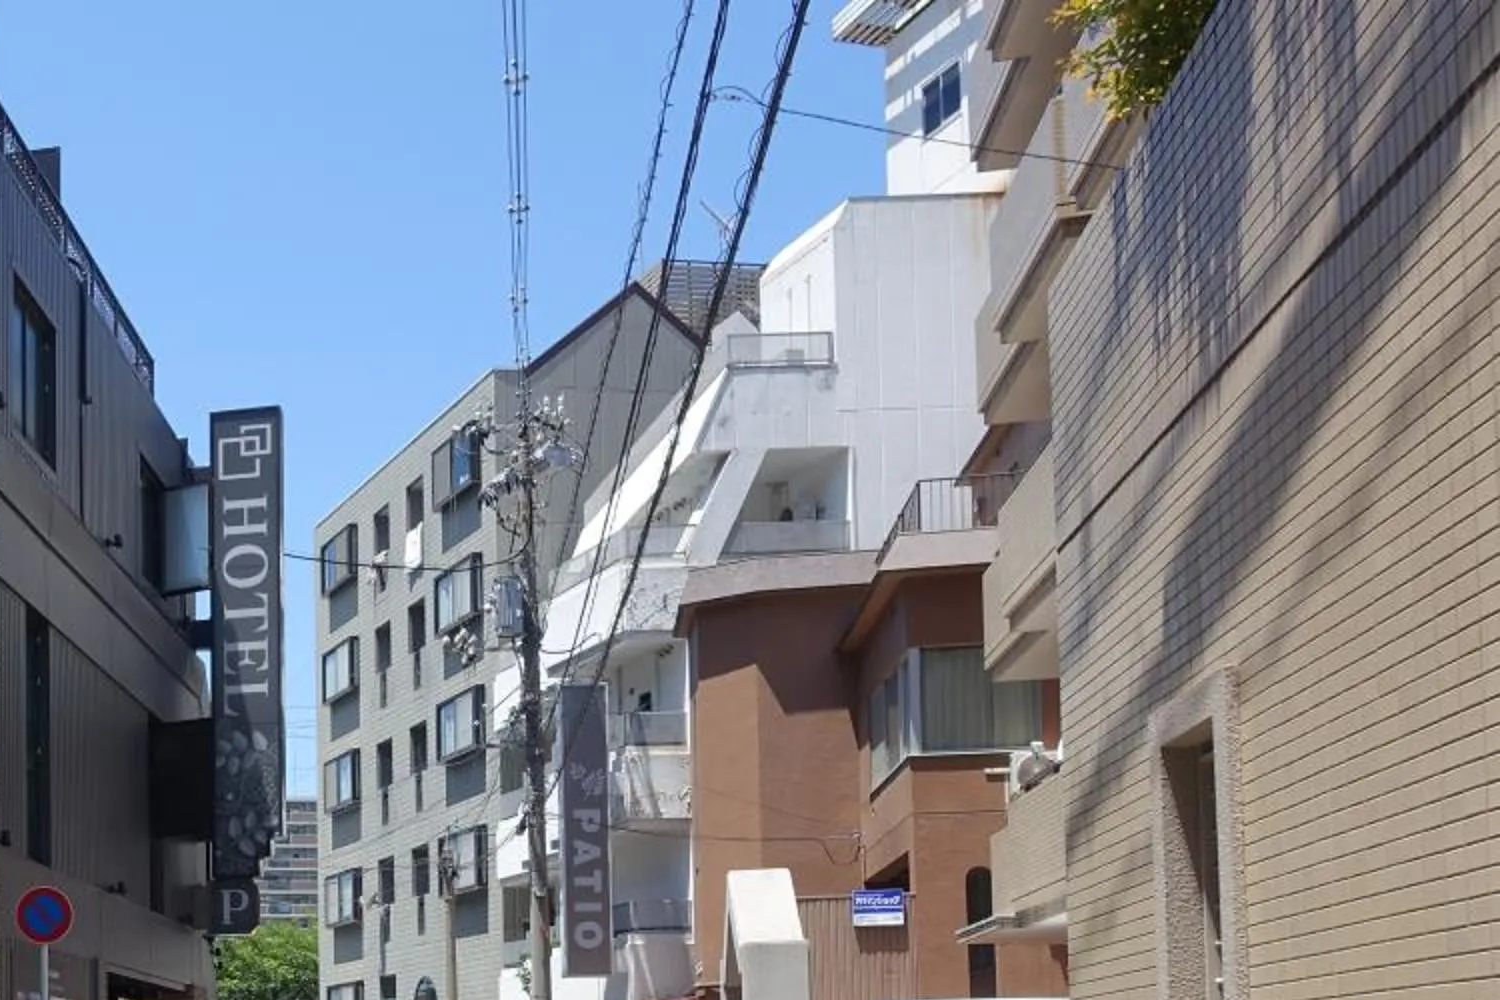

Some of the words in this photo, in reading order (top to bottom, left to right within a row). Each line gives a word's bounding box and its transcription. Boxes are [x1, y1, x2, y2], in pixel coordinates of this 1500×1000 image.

[222, 495, 269, 717] HOTEL
[221, 889, 249, 926] P
[573, 807, 603, 950] PATIO
